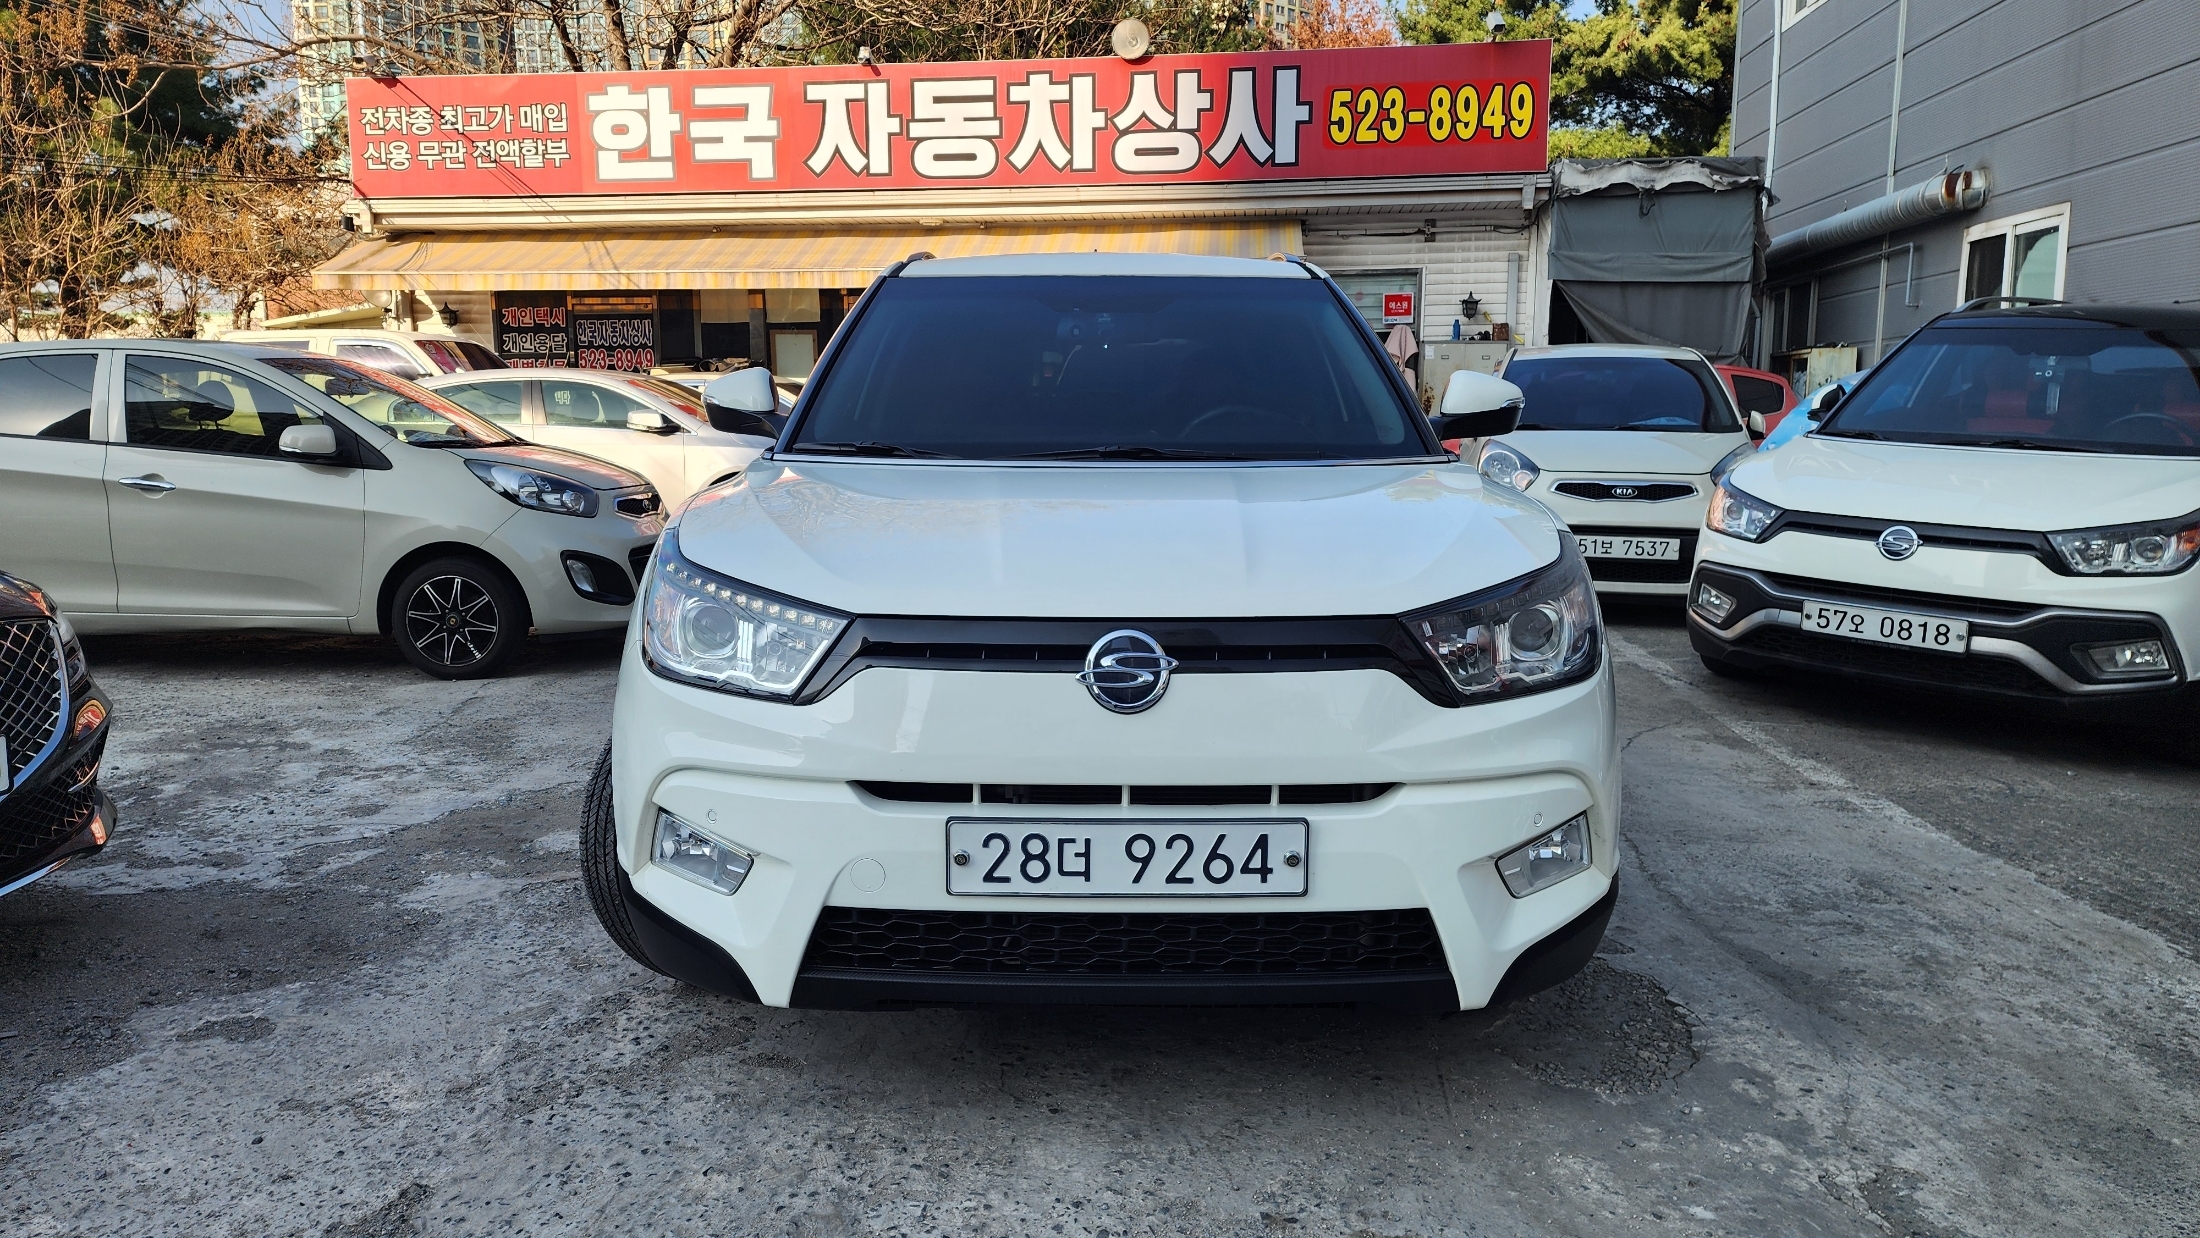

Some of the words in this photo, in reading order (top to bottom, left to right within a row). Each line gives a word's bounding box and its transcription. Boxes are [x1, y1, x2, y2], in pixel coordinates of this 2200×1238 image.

[360, 105, 434, 136] 전차종
[439, 103, 515, 134] 최고가
[518, 102, 569, 133] 매입
[585, 83, 781, 183] 한국
[803, 65, 1313, 179] 자동차상사
[1327, 81, 1535, 146] 523-8949
[361, 140, 412, 171] 신용
[417, 139, 467, 170] 무관
[472, 138, 571, 169] 전액할부
[502, 307, 566, 327] 개인택시
[576, 319, 653, 346] 한국자동차상사
[502, 333, 567, 353] 개인용달
[578, 348, 655, 371] 523-8949
[1578, 538, 1613, 554] 51보
[1622, 540, 1670, 557] 7537
[1816, 607, 1865, 634] 57오
[1880, 616, 1951, 646] 0818
[981, 832, 1091, 883] 28더
[1124, 833, 1274, 885] 9264
